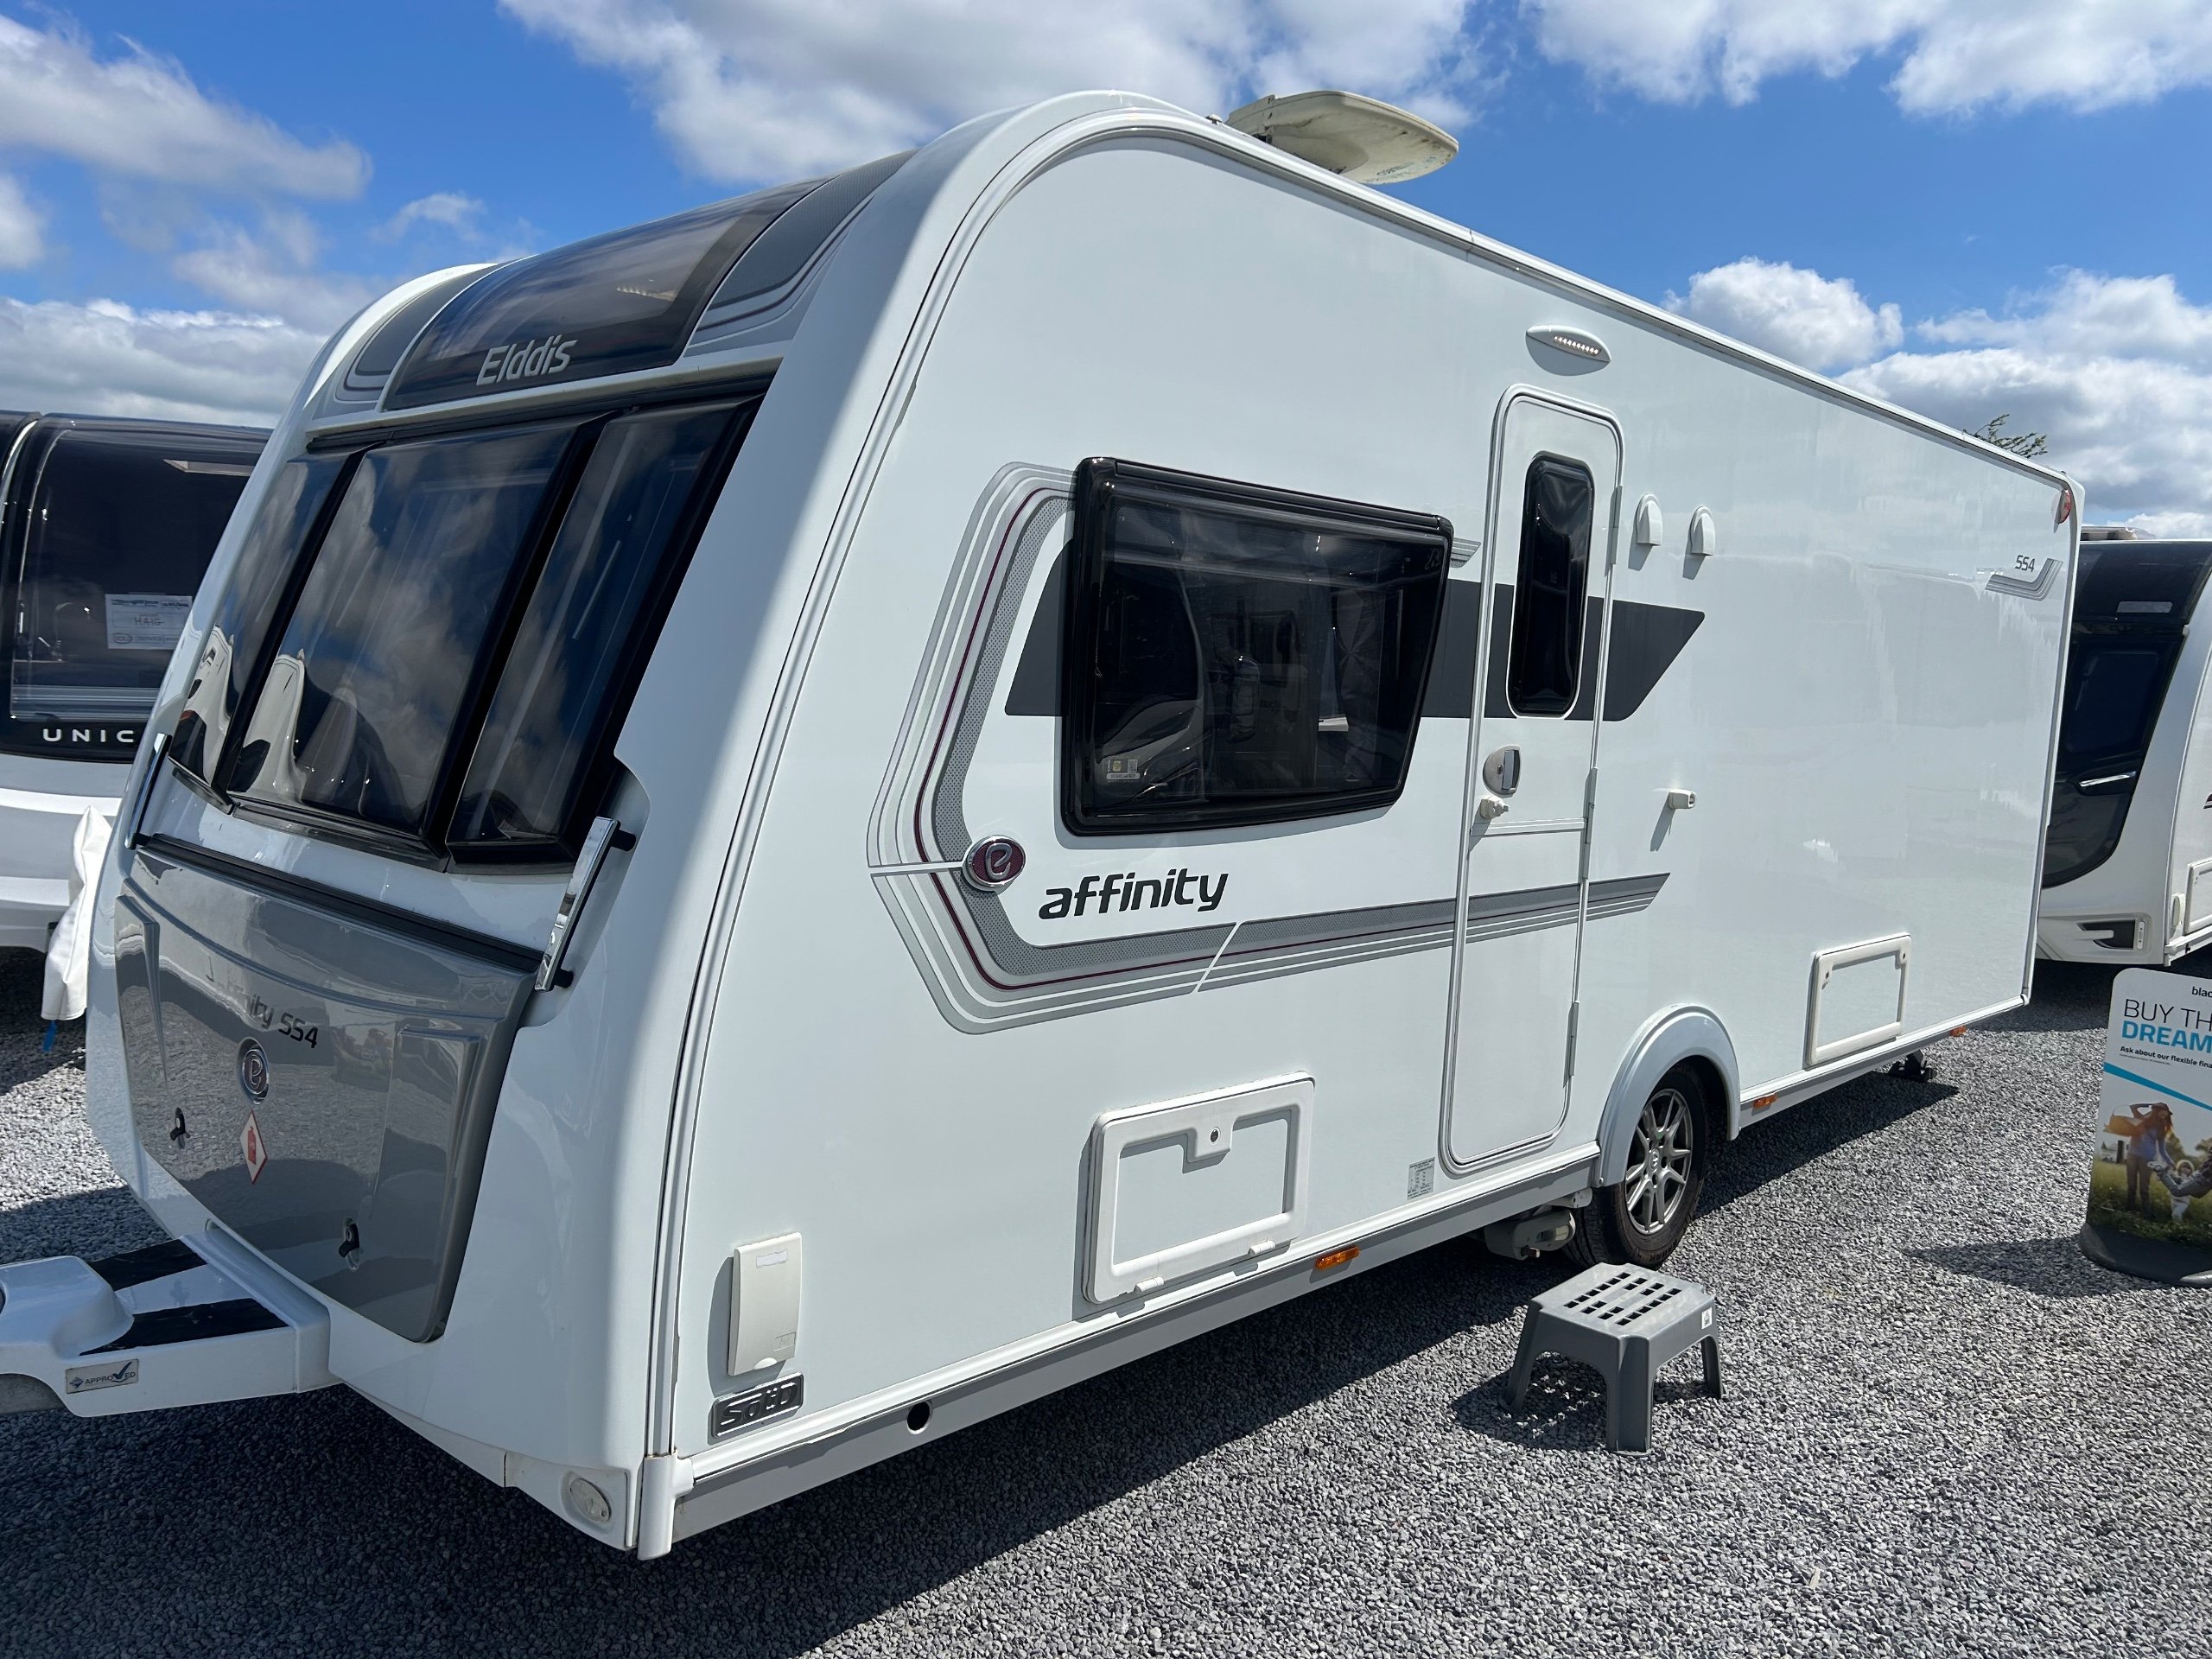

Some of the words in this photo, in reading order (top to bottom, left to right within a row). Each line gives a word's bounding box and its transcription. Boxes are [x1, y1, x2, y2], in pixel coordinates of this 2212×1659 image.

[476, 334, 579, 386] Elddis
[2014, 554, 2036, 573] 554
[1038, 868, 1229, 920] affinity
[277, 1012, 319, 1049] 554
[2124, 998, 2175, 1024] BUY
[2180, 1007, 2212, 1032] TH
[2121, 1020, 2212, 1054] DREAM
[2134, 1048, 2156, 1058] about
[2171, 1055, 2197, 1065] flexible
